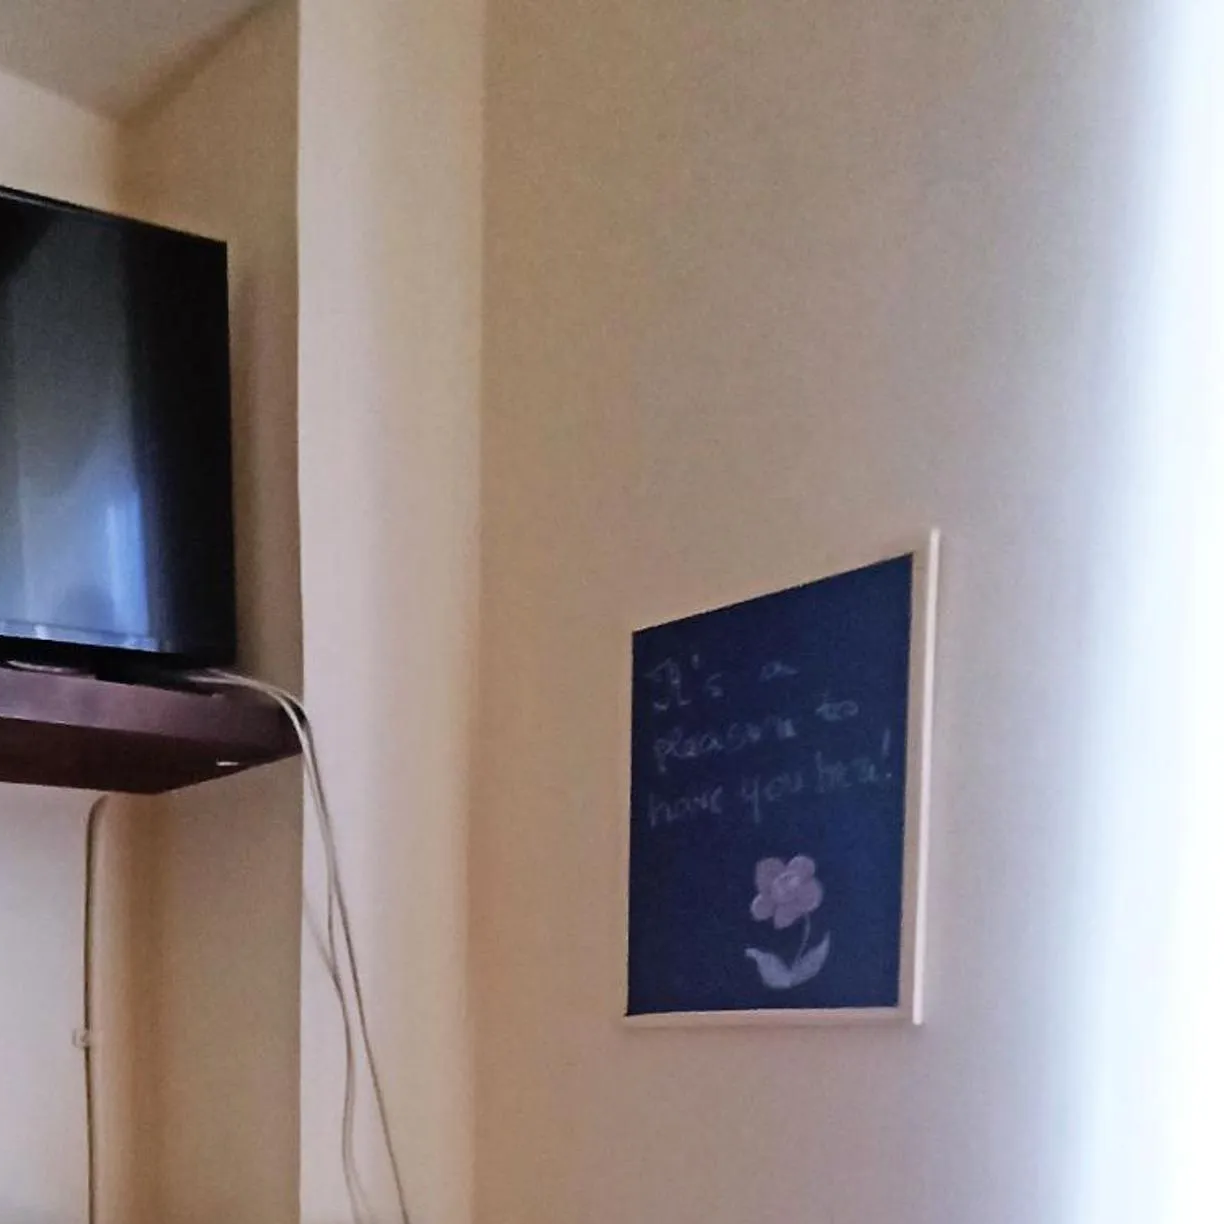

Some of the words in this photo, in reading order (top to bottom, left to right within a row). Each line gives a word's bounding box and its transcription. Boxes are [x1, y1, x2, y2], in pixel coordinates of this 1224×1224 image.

[760, 660, 799, 682] a
[817, 691, 859, 721] to
[742, 773, 806, 823] you
